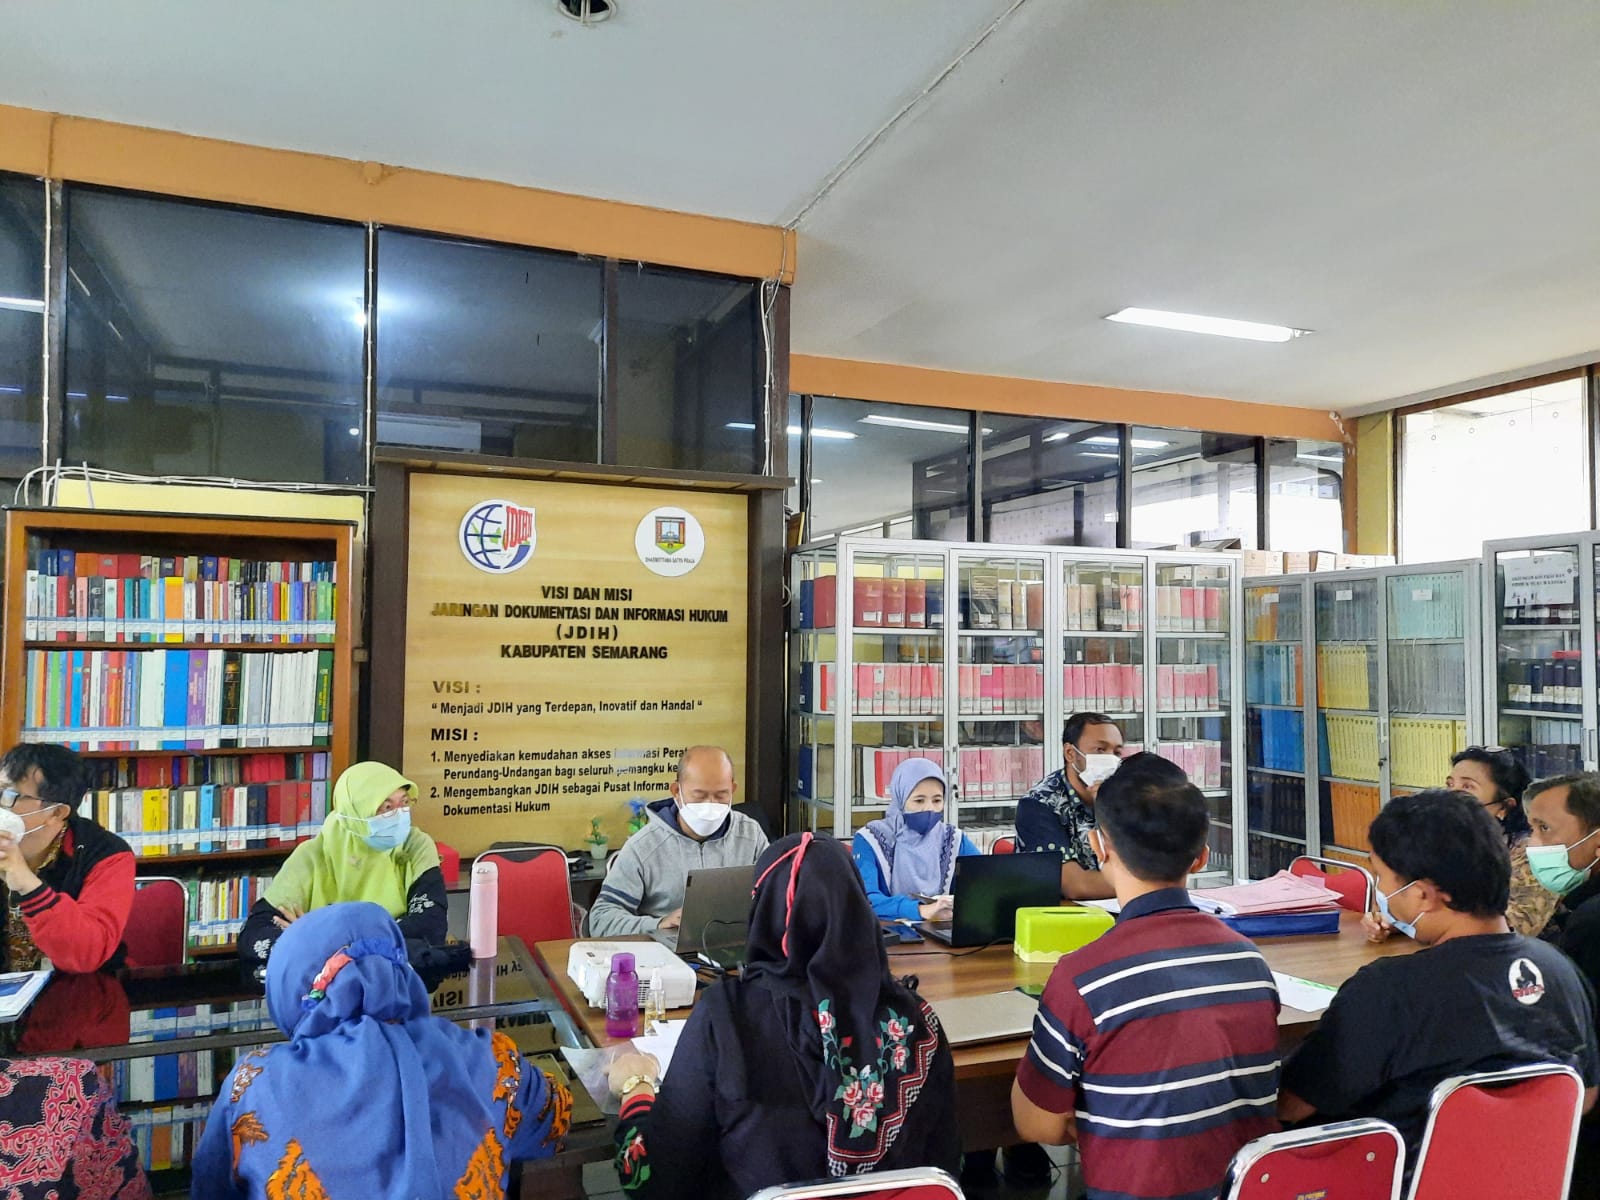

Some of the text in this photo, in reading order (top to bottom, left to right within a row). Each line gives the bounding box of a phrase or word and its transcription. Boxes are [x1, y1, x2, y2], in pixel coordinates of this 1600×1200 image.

[541, 585, 632, 601] VISI DAN MISI
[431, 602, 728, 622] JARINGAN DOKUMENTASI DAN INFORMASI HUKUM
[500, 644, 668, 659] KABUPATEN SEMARANG
[432, 680, 470, 694] VISI
[440, 702, 484, 716] Menjadi
[486, 701, 513, 714] JDIH
[516, 703, 542, 716] yang
[544, 701, 596, 714] Terdepan,
[599, 700, 637, 712] Inovatif
[640, 700, 658, 711] dan
[661, 699, 695, 711] Handal
[431, 728, 468, 741] MISI
[431, 750, 441, 763] 1.
[444, 749, 515, 764] Menyediakan
[518, 749, 578, 761] kemudahan
[581, 748, 611, 760] akses
[444, 766, 552, 781] Perundang-Undangan
[554, 765, 576, 778] bagi
[578, 764, 614, 777] seluruh
[430, 786, 440, 799] 2.
[443, 784, 532, 800] Mengembangkan
[534, 783, 559, 795] JDIH
[562, 782, 600, 796] sebagai
[603, 781, 631, 793] Pusat
[443, 800, 551, 816] Dokumentasi Hukum
